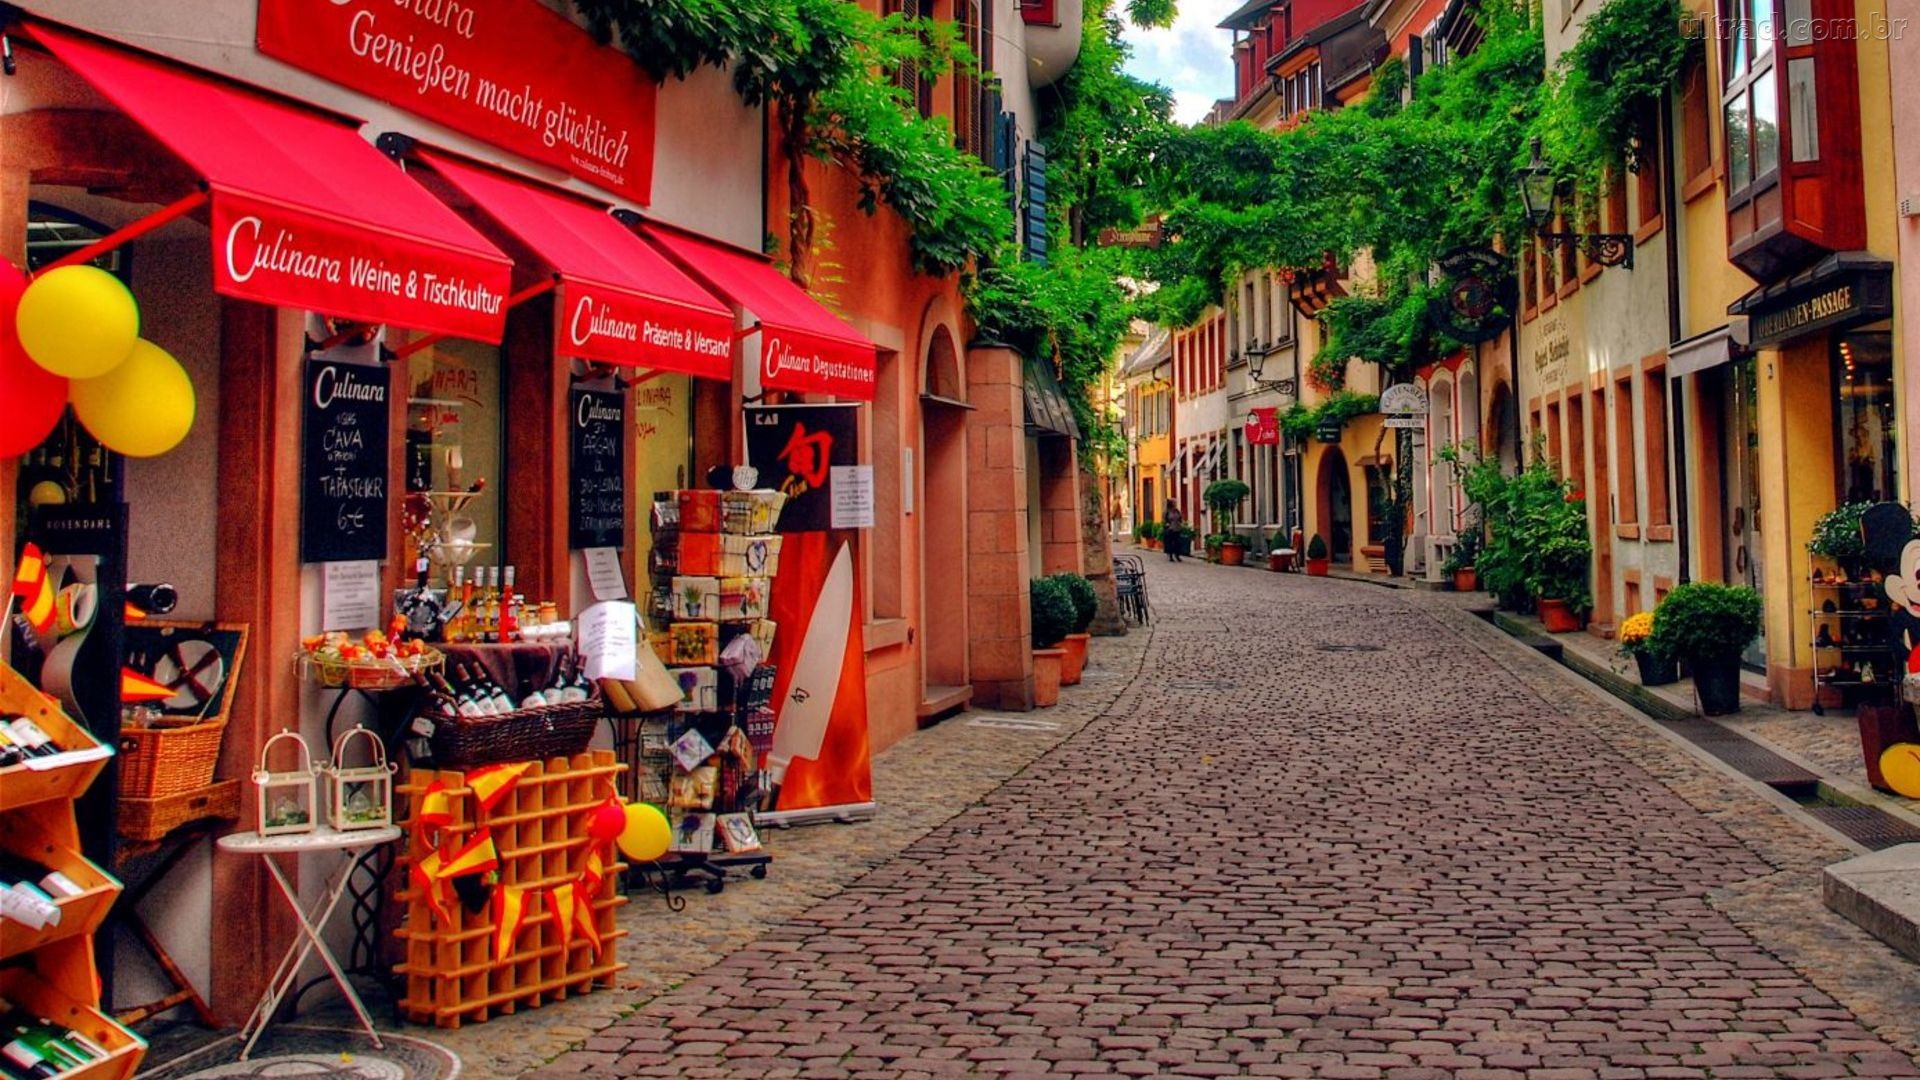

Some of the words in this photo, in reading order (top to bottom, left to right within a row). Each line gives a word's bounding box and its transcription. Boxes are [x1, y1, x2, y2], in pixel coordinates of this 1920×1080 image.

[349, 10, 470, 100] Genießen
[475, 78, 543, 130] macht
[543, 101, 629, 169] glücklich
[226, 216, 341, 283] Culinara
[350, 256, 401, 295] Weine
[405, 269, 418, 299] &
[423, 273, 503, 315] Tischkultur
[571, 295, 637, 346] Culinara
[642, 320, 683, 350] Präsente
[684, 328, 692, 351] &
[694, 330, 731, 359] Versand
[766, 338, 811, 378] Culinara
[813, 355, 875, 383] Degustationen
[315, 366, 384, 410] Culinara
[578, 394, 621, 428] Culinara
[323, 426, 364, 451] CAVA
